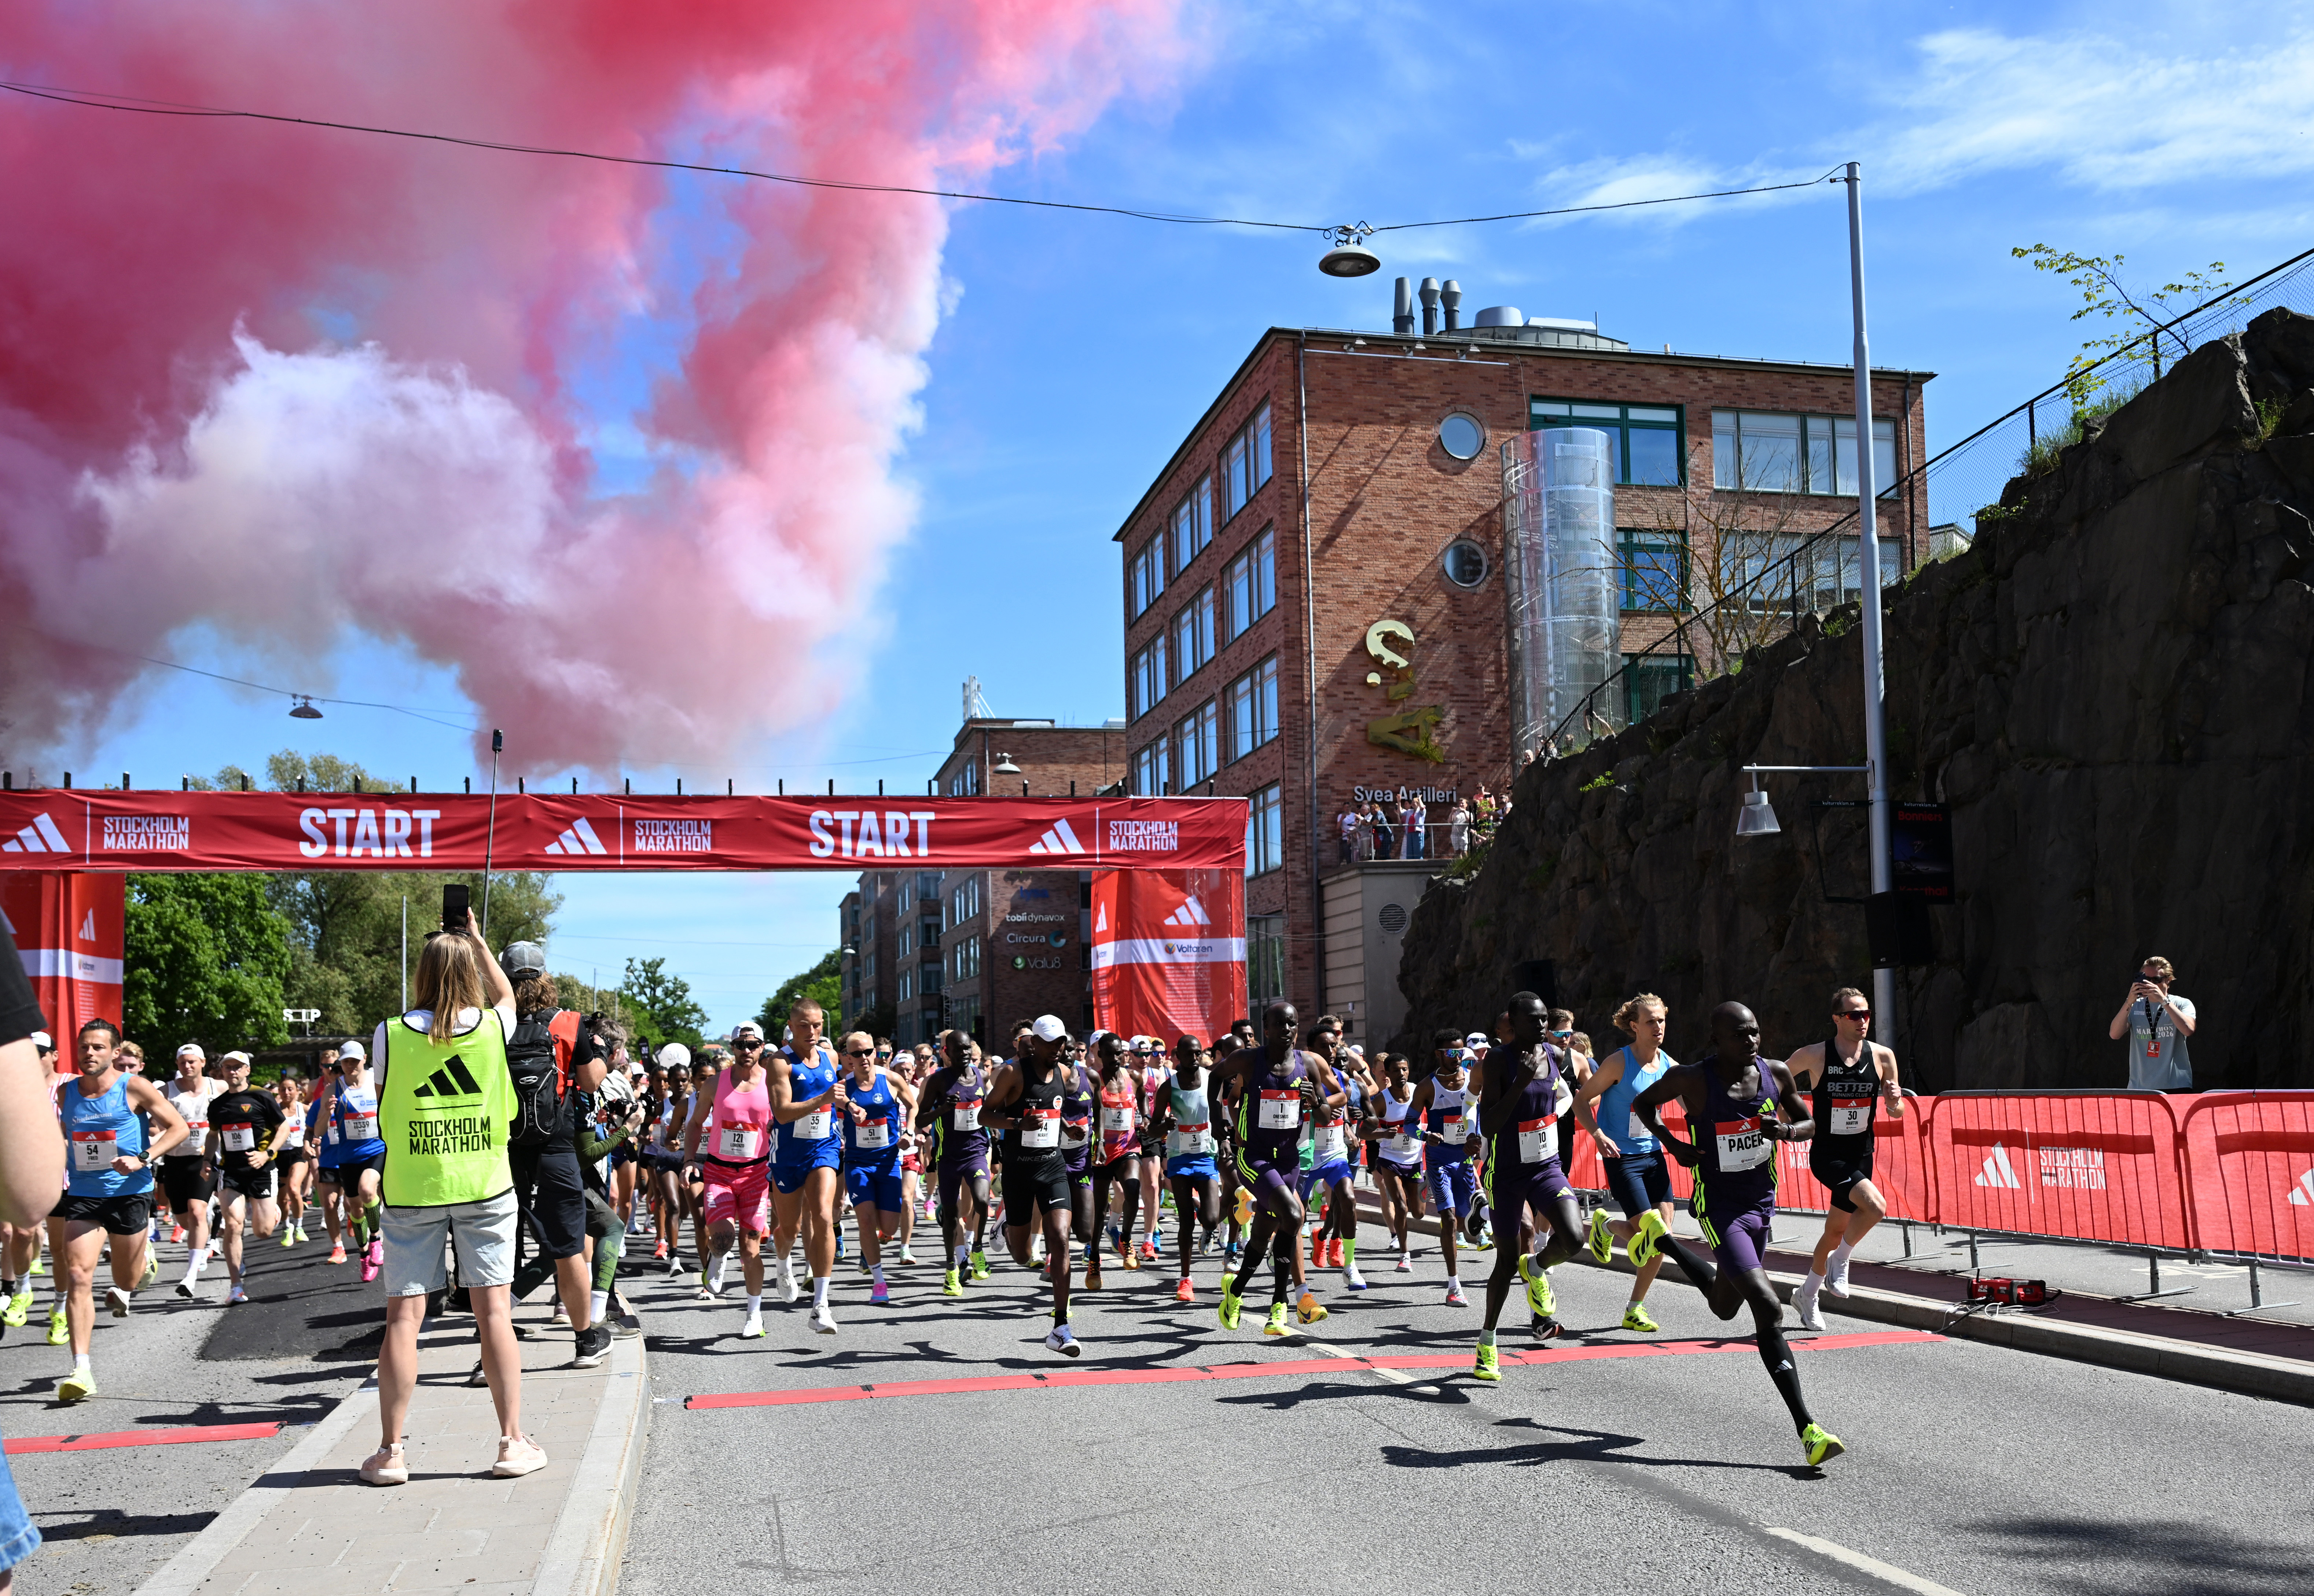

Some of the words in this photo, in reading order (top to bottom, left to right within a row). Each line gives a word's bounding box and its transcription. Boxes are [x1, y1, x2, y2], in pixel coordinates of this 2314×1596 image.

[1354, 785, 1393, 803] Svea
[1399, 785, 1457, 803] Artilleri
[1898, 810, 1943, 821] Bonniers
[104, 818, 189, 835] STOCKHOLM
[635, 820, 712, 836] STOCKHOLM
[1109, 821, 1178, 836] STOCKHOLM
[299, 808, 440, 858] START
[809, 810, 936, 858] START
[103, 834, 189, 851] MARATHON
[635, 836, 712, 851] MARATHON
[1109, 835, 1178, 851] MARATHON
[1899, 886, 1948, 896] Kthall
[1007, 933, 1046, 943] Circura
[1176, 944, 1212, 953] Voltaren
[1028, 957, 1061, 969] Valu8
[2136, 1026, 2173, 1035] MARTHON
[1828, 1066, 1844, 1074] BRC
[1828, 1082, 1873, 1092] BETTER
[1280, 1103, 1283, 1113] 1
[811, 1116, 819, 1125] 35
[1847, 1111, 1857, 1120] 30
[353, 1121, 369, 1130] 11339
[409, 1116, 491, 1137] STOCKHOLM
[733, 1133, 743, 1142] 121
[1329, 1130, 1333, 1138] 7
[1538, 1131, 1546, 1144] 10
[409, 1133, 492, 1155] MARATHON
[1728, 1134, 1764, 1152] PACER
[86, 1144, 99, 1155] 54
[1041, 1151, 1057, 1160] PRO
[2039, 1146, 2104, 1168] STOCKHOLM
[2041, 1166, 2107, 1190] MARATHON
